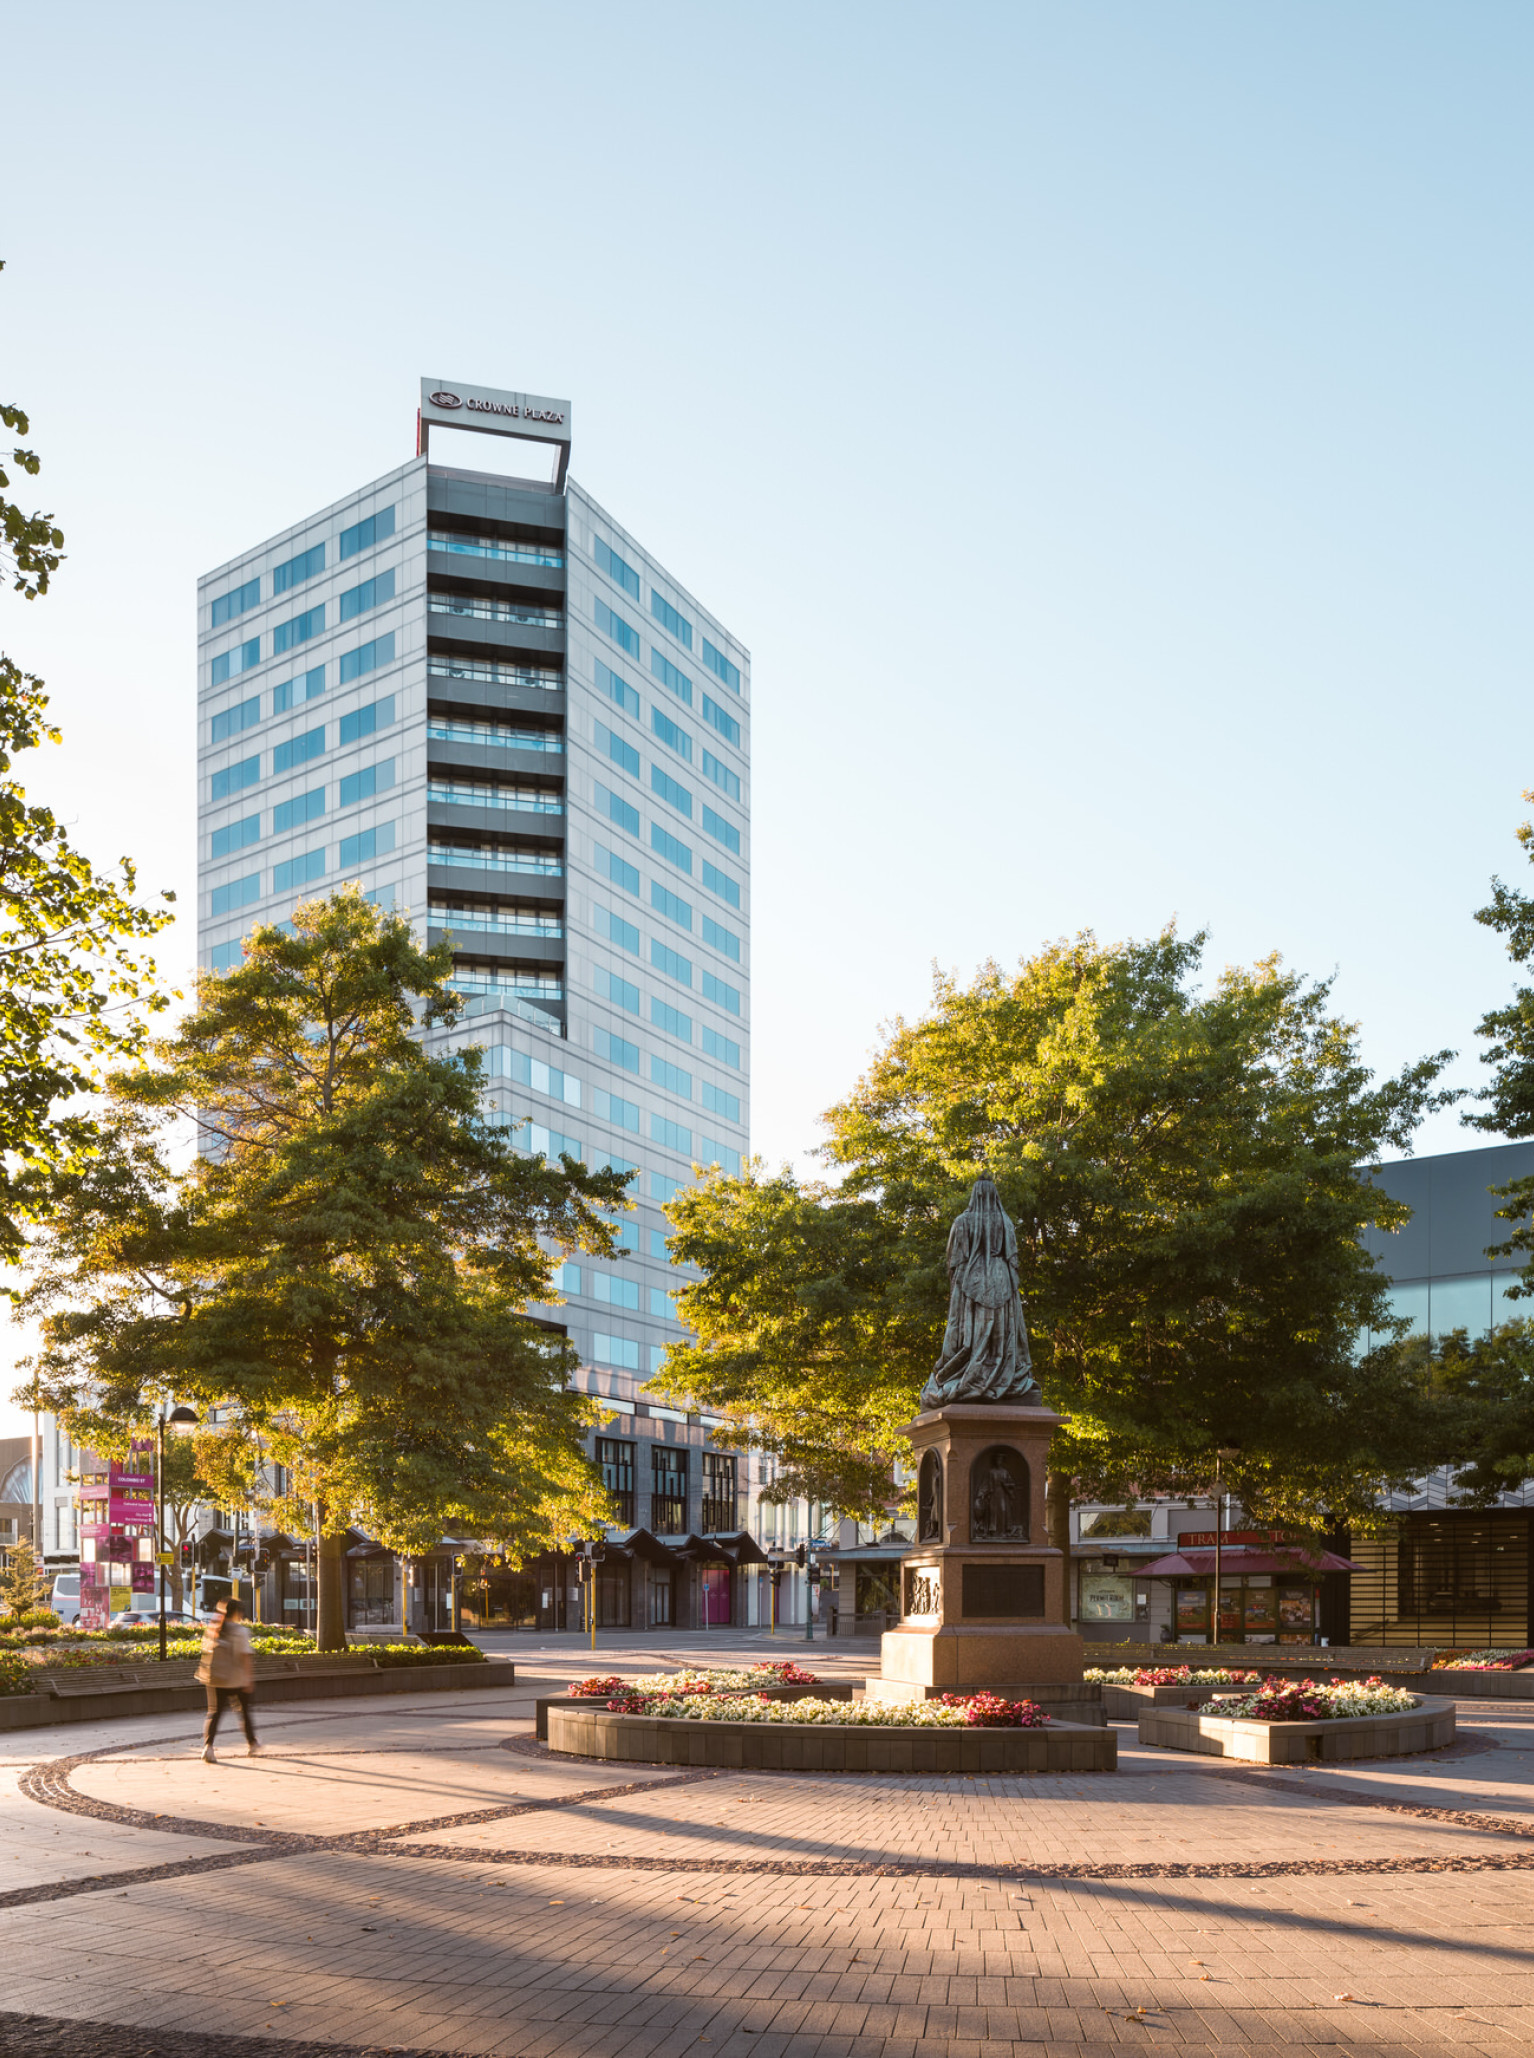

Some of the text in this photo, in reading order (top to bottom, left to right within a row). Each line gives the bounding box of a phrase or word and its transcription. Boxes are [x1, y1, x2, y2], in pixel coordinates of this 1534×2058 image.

[466, 398, 564, 424] CROWNE PLAZA
[1188, 1533, 1229, 1545] TRAM
